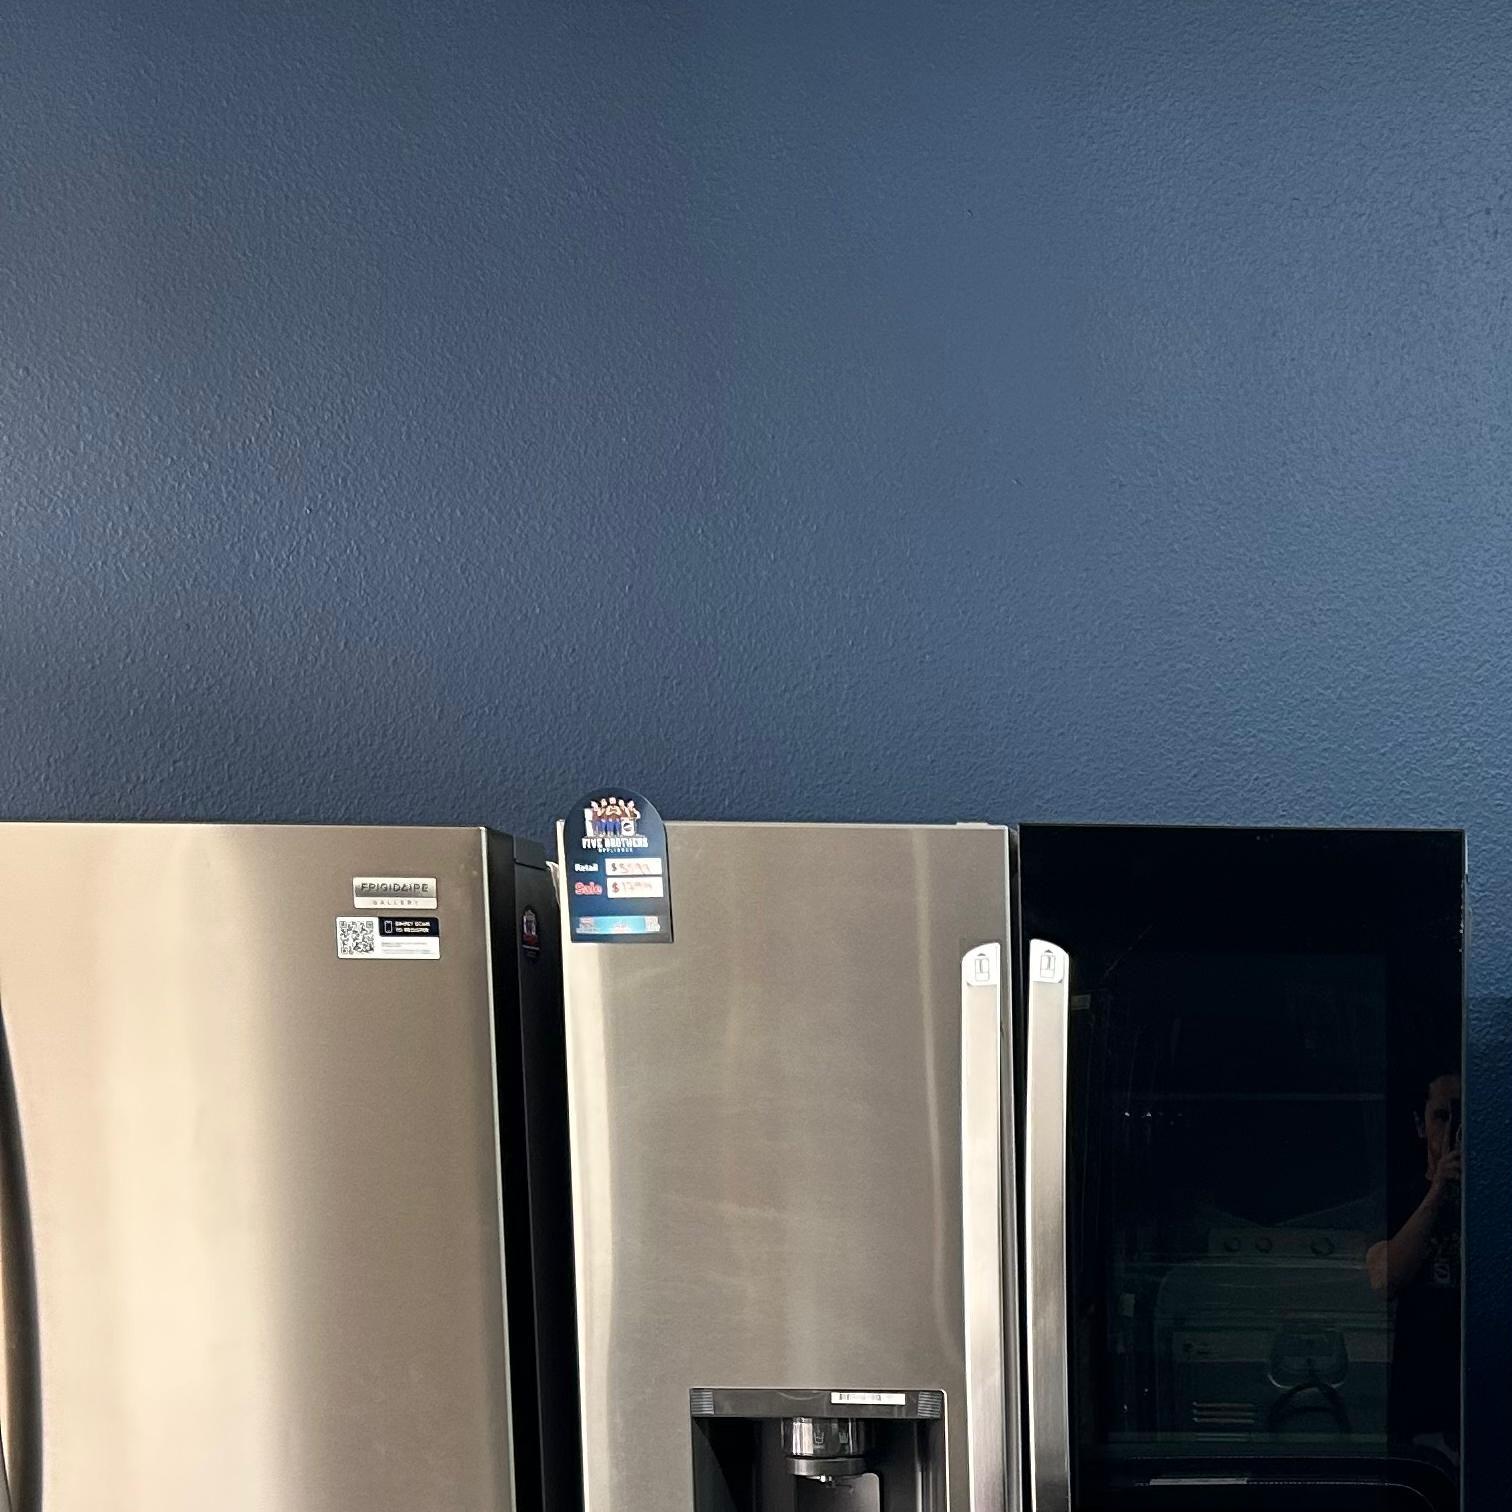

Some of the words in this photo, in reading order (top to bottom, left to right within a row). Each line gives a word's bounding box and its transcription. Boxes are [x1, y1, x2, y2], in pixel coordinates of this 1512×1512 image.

[574, 863, 599, 872] Retail
[360, 882, 429, 893] FRIGIDAIRE
[575, 882, 602, 895] Sale
